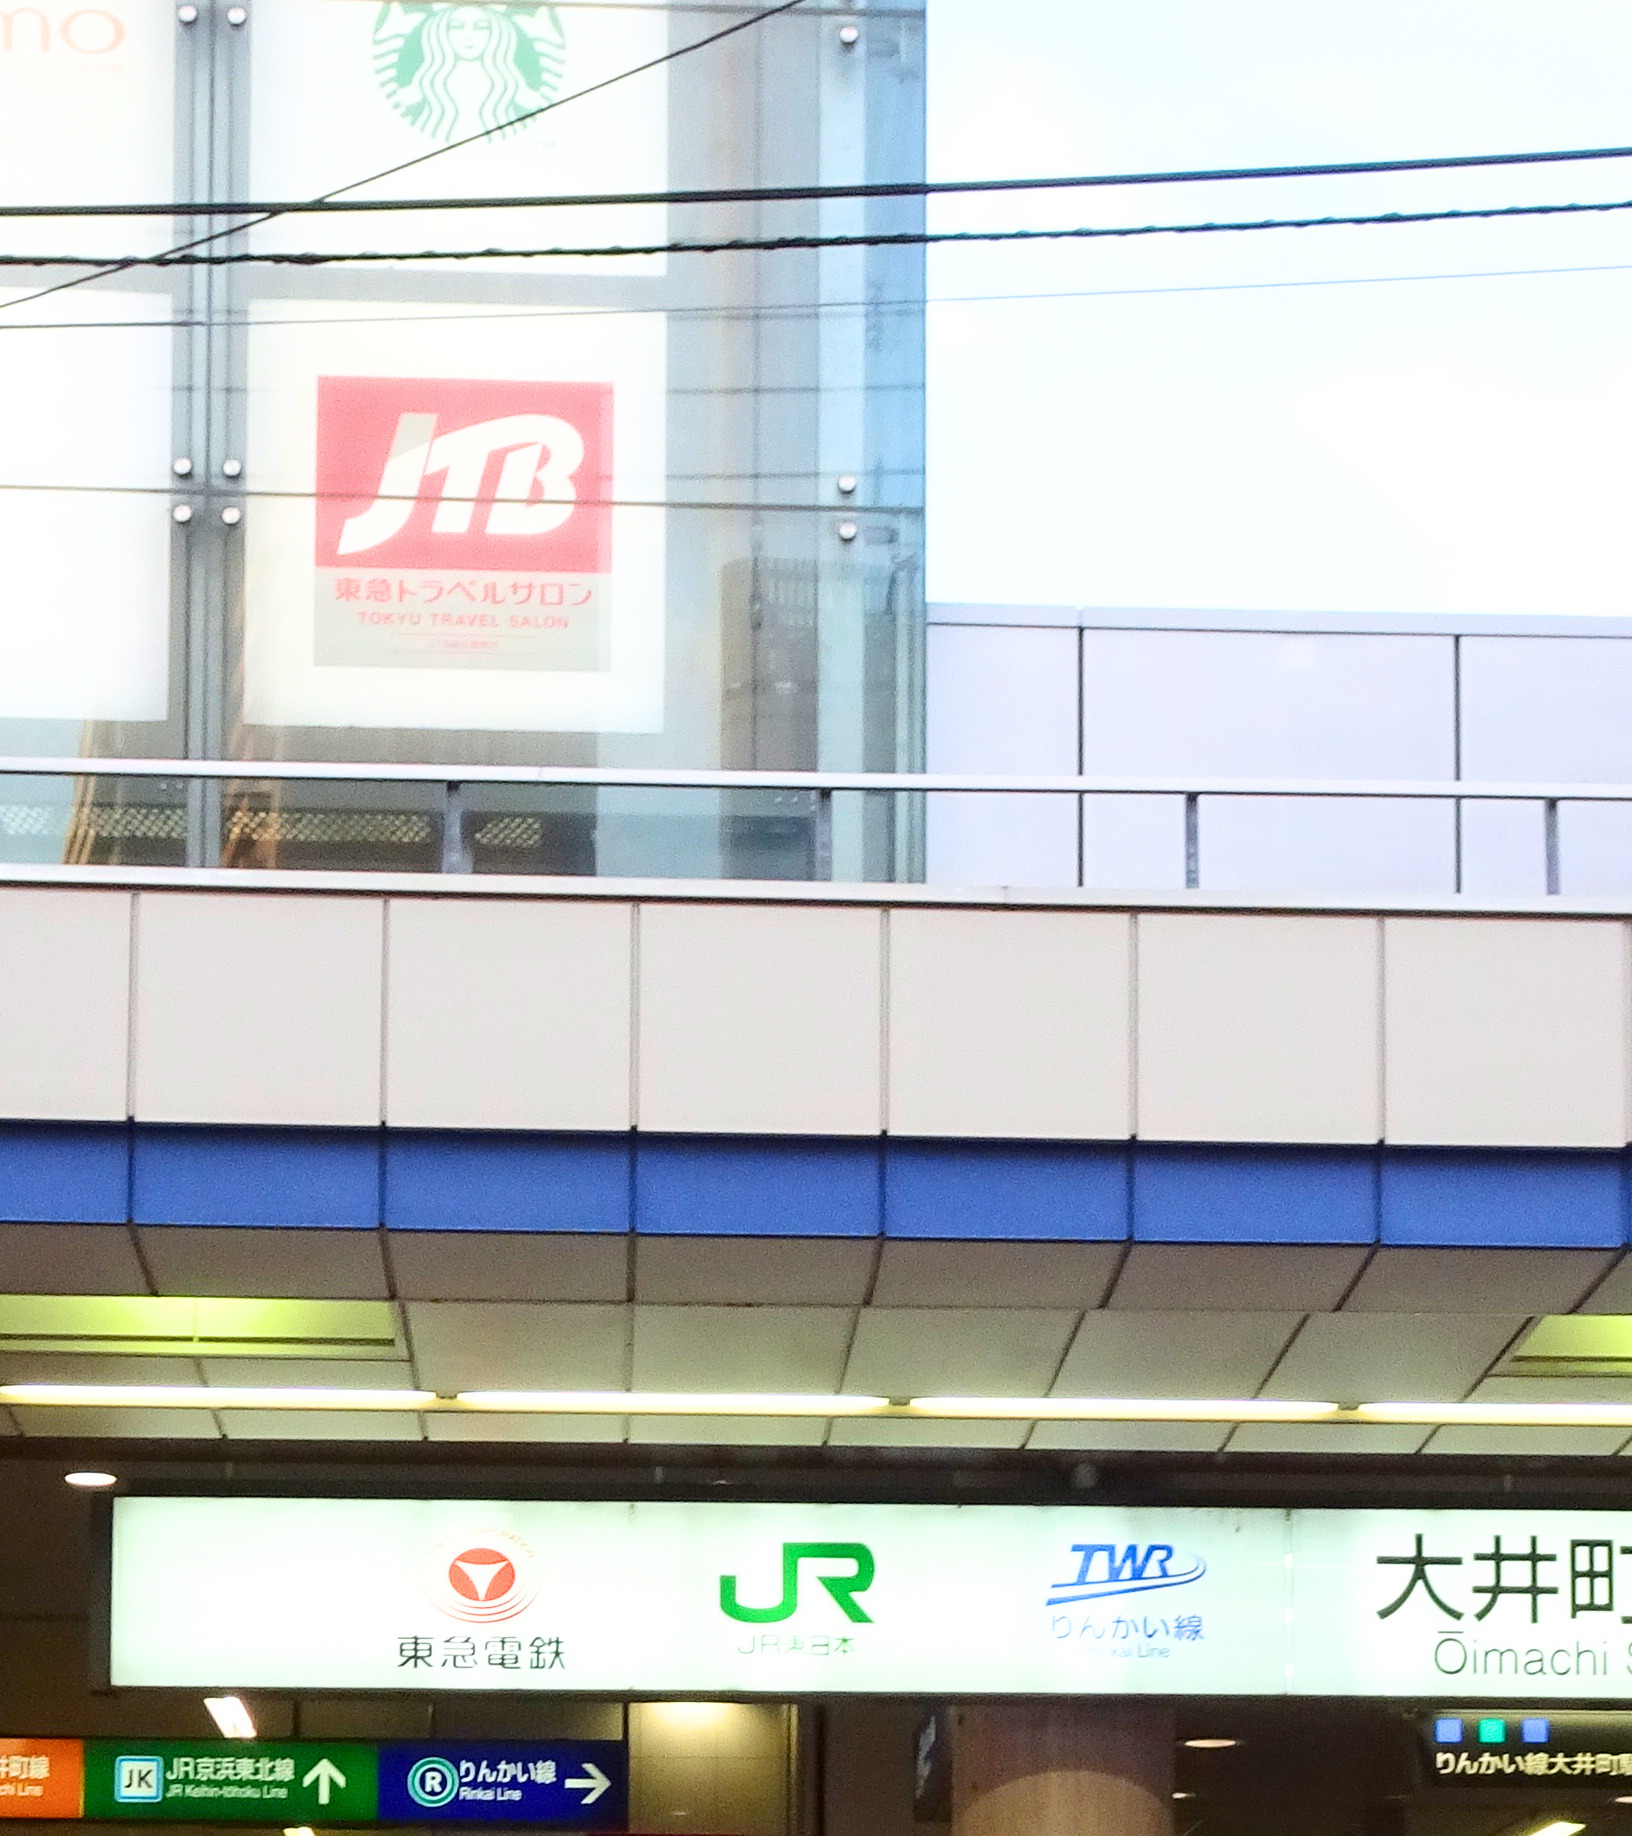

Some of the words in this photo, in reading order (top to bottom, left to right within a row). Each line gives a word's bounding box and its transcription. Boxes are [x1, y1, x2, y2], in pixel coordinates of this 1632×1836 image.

[338, 413, 584, 555] JTB
[334, 577, 593, 607] 東急トラベルサロン
[357, 611, 422, 627] TOKYU
[430, 612, 500, 628] TRAVEL
[509, 614, 571, 630] SALON
[1070, 1543, 1174, 1584] TWR
[720, 1543, 875, 1623] JR
[1051, 1614, 1205, 1641] りんかい線
[397, 1636, 565, 1669] 東急電鉄
[738, 1635, 856, 1656] JR東日本
[1434, 1631, 1609, 1677] Ōimachi
[124, 1769, 154, 1789] JK
[165, 1757, 296, 1782] JR京浜東北線
[424, 1771, 443, 1793] R
[459, 1759, 558, 1784] りんかい線
[16, 1782, 44, 1797] Line
[165, 1784, 184, 1798] JR
[262, 1784, 289, 1799] Line
[458, 1786, 496, 1801] Rinkai
[495, 1786, 523, 1801] Line
